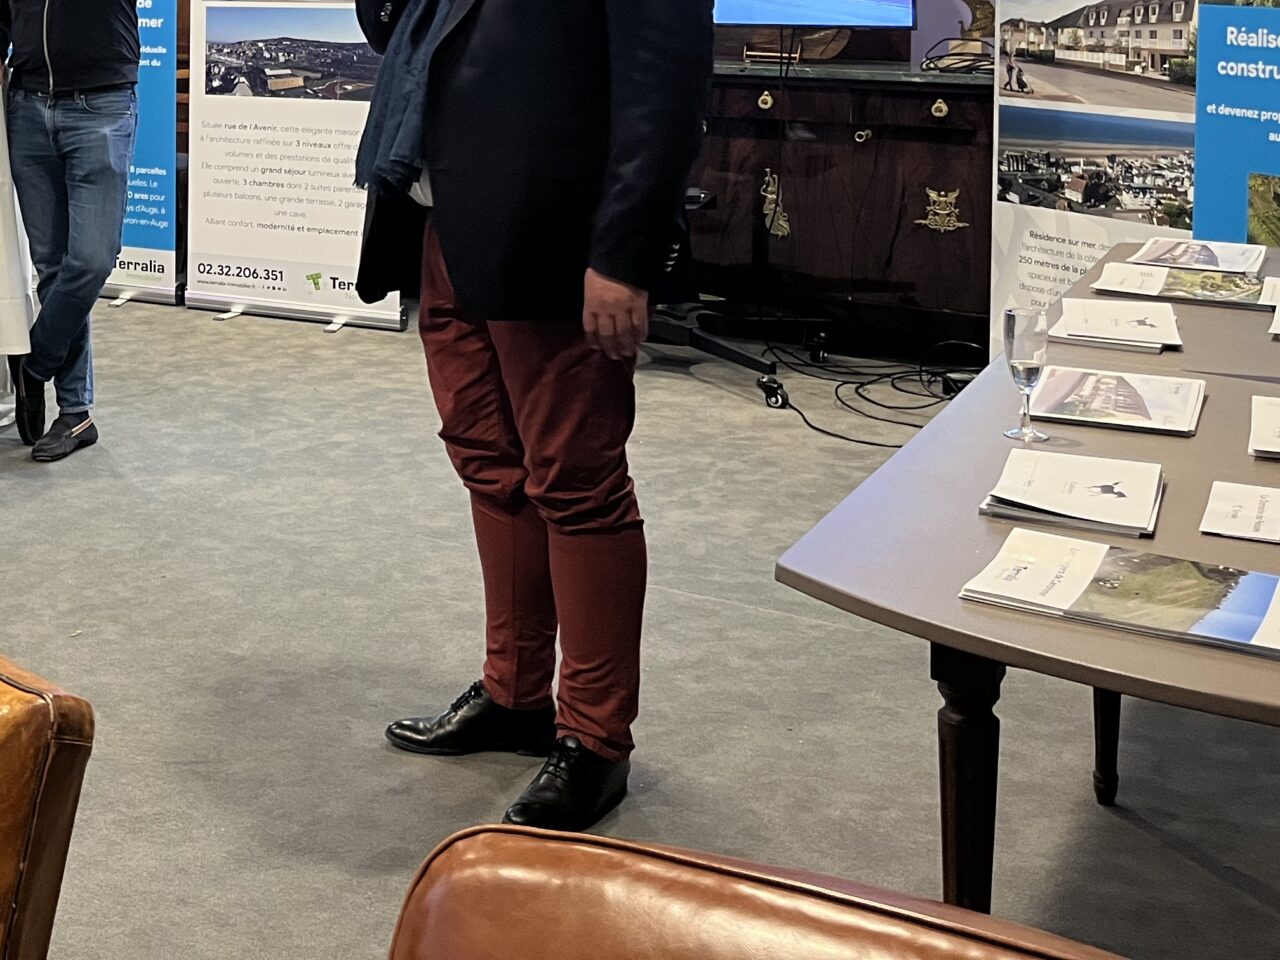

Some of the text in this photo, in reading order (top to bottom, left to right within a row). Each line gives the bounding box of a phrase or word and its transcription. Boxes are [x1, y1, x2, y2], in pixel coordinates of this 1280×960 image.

[140, 45, 167, 54] viduelle
[1217, 60, 1280, 81] constru
[1206, 103, 1280, 124] et devenez pro
[344, 201, 366, 209] garag
[1029, 230, 1067, 244] Résidence
[197, 262, 284, 282] 02.32.206.351
[1018, 255, 1033, 265] 250
[1061, 264, 1070, 272] de
[1072, 265, 1079, 273] la
[329, 276, 354, 290] Ter
